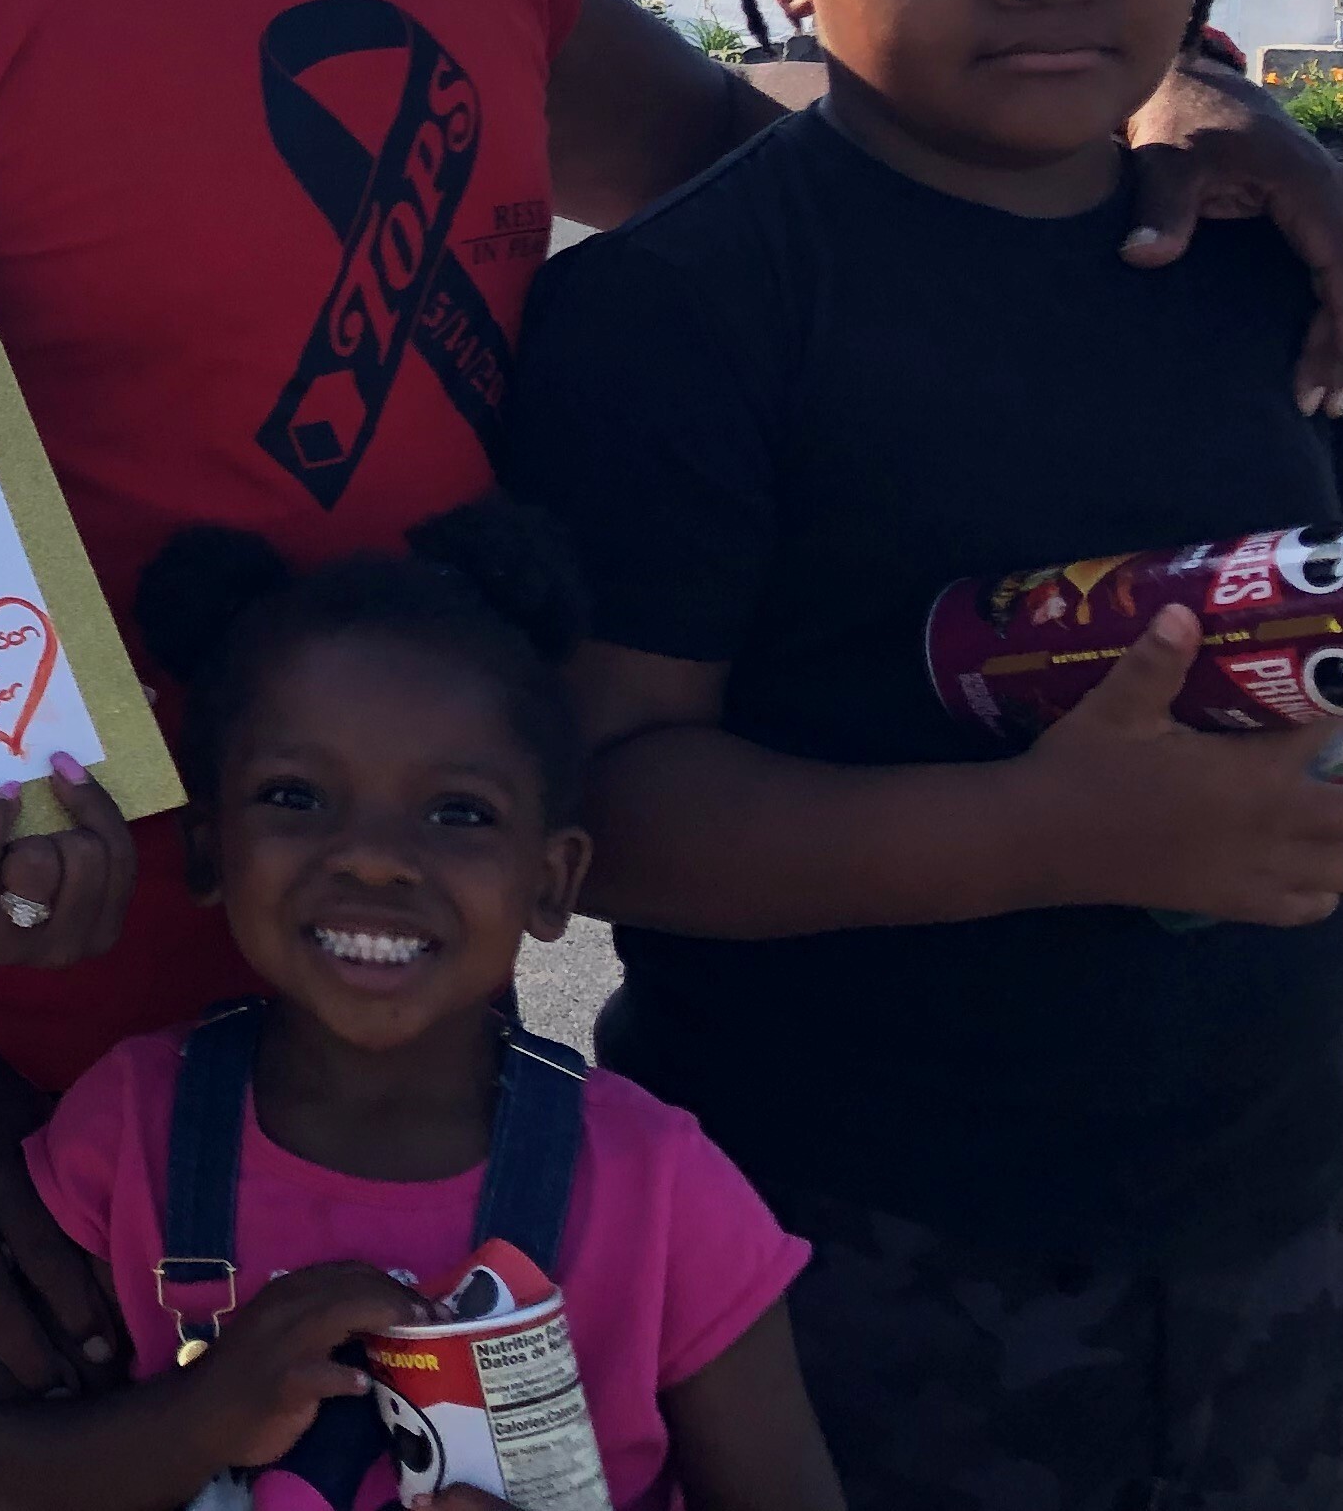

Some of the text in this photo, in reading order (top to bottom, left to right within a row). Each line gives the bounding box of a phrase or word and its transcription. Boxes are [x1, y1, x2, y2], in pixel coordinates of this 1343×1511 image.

[477, 1333, 544, 1357] Nutrition
[381, 1350, 441, 1372] FLAVOR
[479, 1352, 528, 1370] Datos
